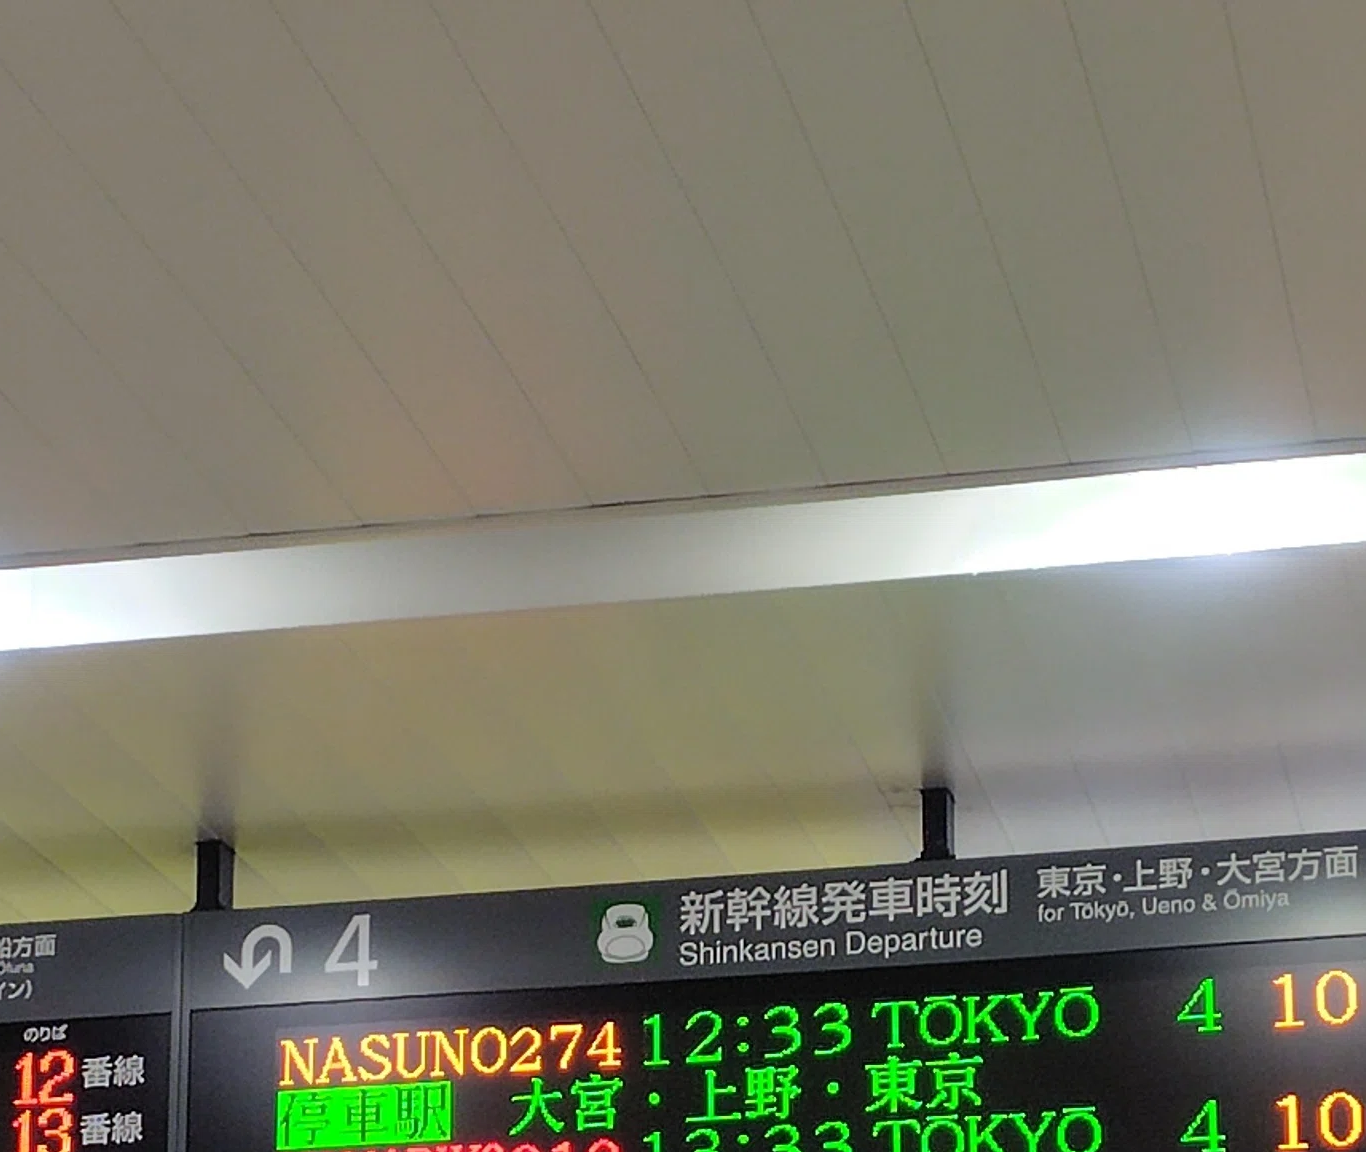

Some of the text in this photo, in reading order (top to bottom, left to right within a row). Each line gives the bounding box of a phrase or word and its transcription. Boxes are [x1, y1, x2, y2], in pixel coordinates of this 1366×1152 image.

[1037, 845, 1359, 900] 東京・上野・大宮方面
[680, 868, 1009, 939] 新幹線発車時刻
[1037, 903, 1063, 923] for
[1142, 892, 1195, 915] Ueno
[1202, 892, 1218, 911] &
[323, 914, 379, 987] 4
[680, 922, 983, 967] Shinkansen Departure
[23, 1023, 69, 1044] のりば
[279, 1020, 623, 1087] NASUNO274
[642, 1001, 853, 1067] 12:33
[871, 983, 1101, 1051] TŌKYŌ
[1176, 977, 1224, 1034] 4
[12, 1048, 76, 1106] 12
[280, 1085, 447, 1147] 停車駅
